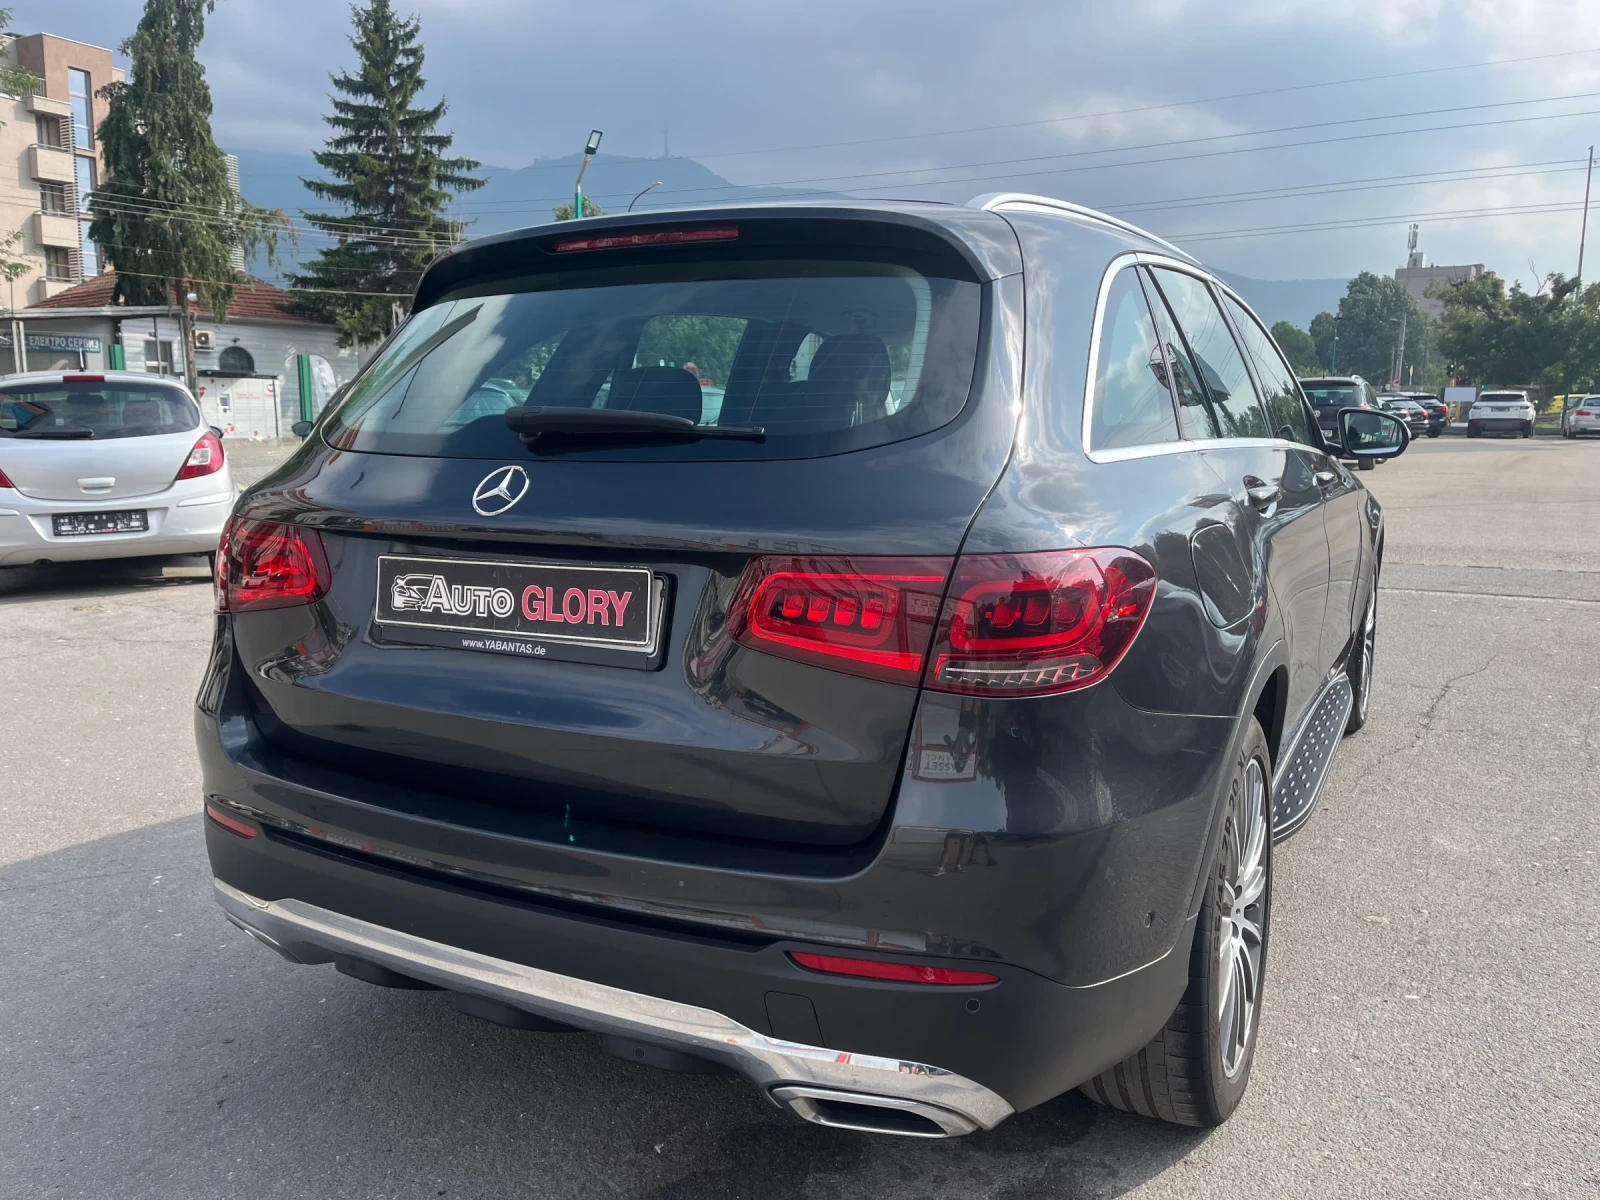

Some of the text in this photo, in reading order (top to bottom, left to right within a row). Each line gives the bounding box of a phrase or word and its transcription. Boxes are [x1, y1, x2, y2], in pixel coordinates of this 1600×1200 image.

[28, 335, 67, 347] ЕЛЕКТРО
[67, 337, 99, 349] СЕРВИЗ
[521, 584, 632, 627] GLORY
[462, 638, 546, 656] www.YABANTAS.de
